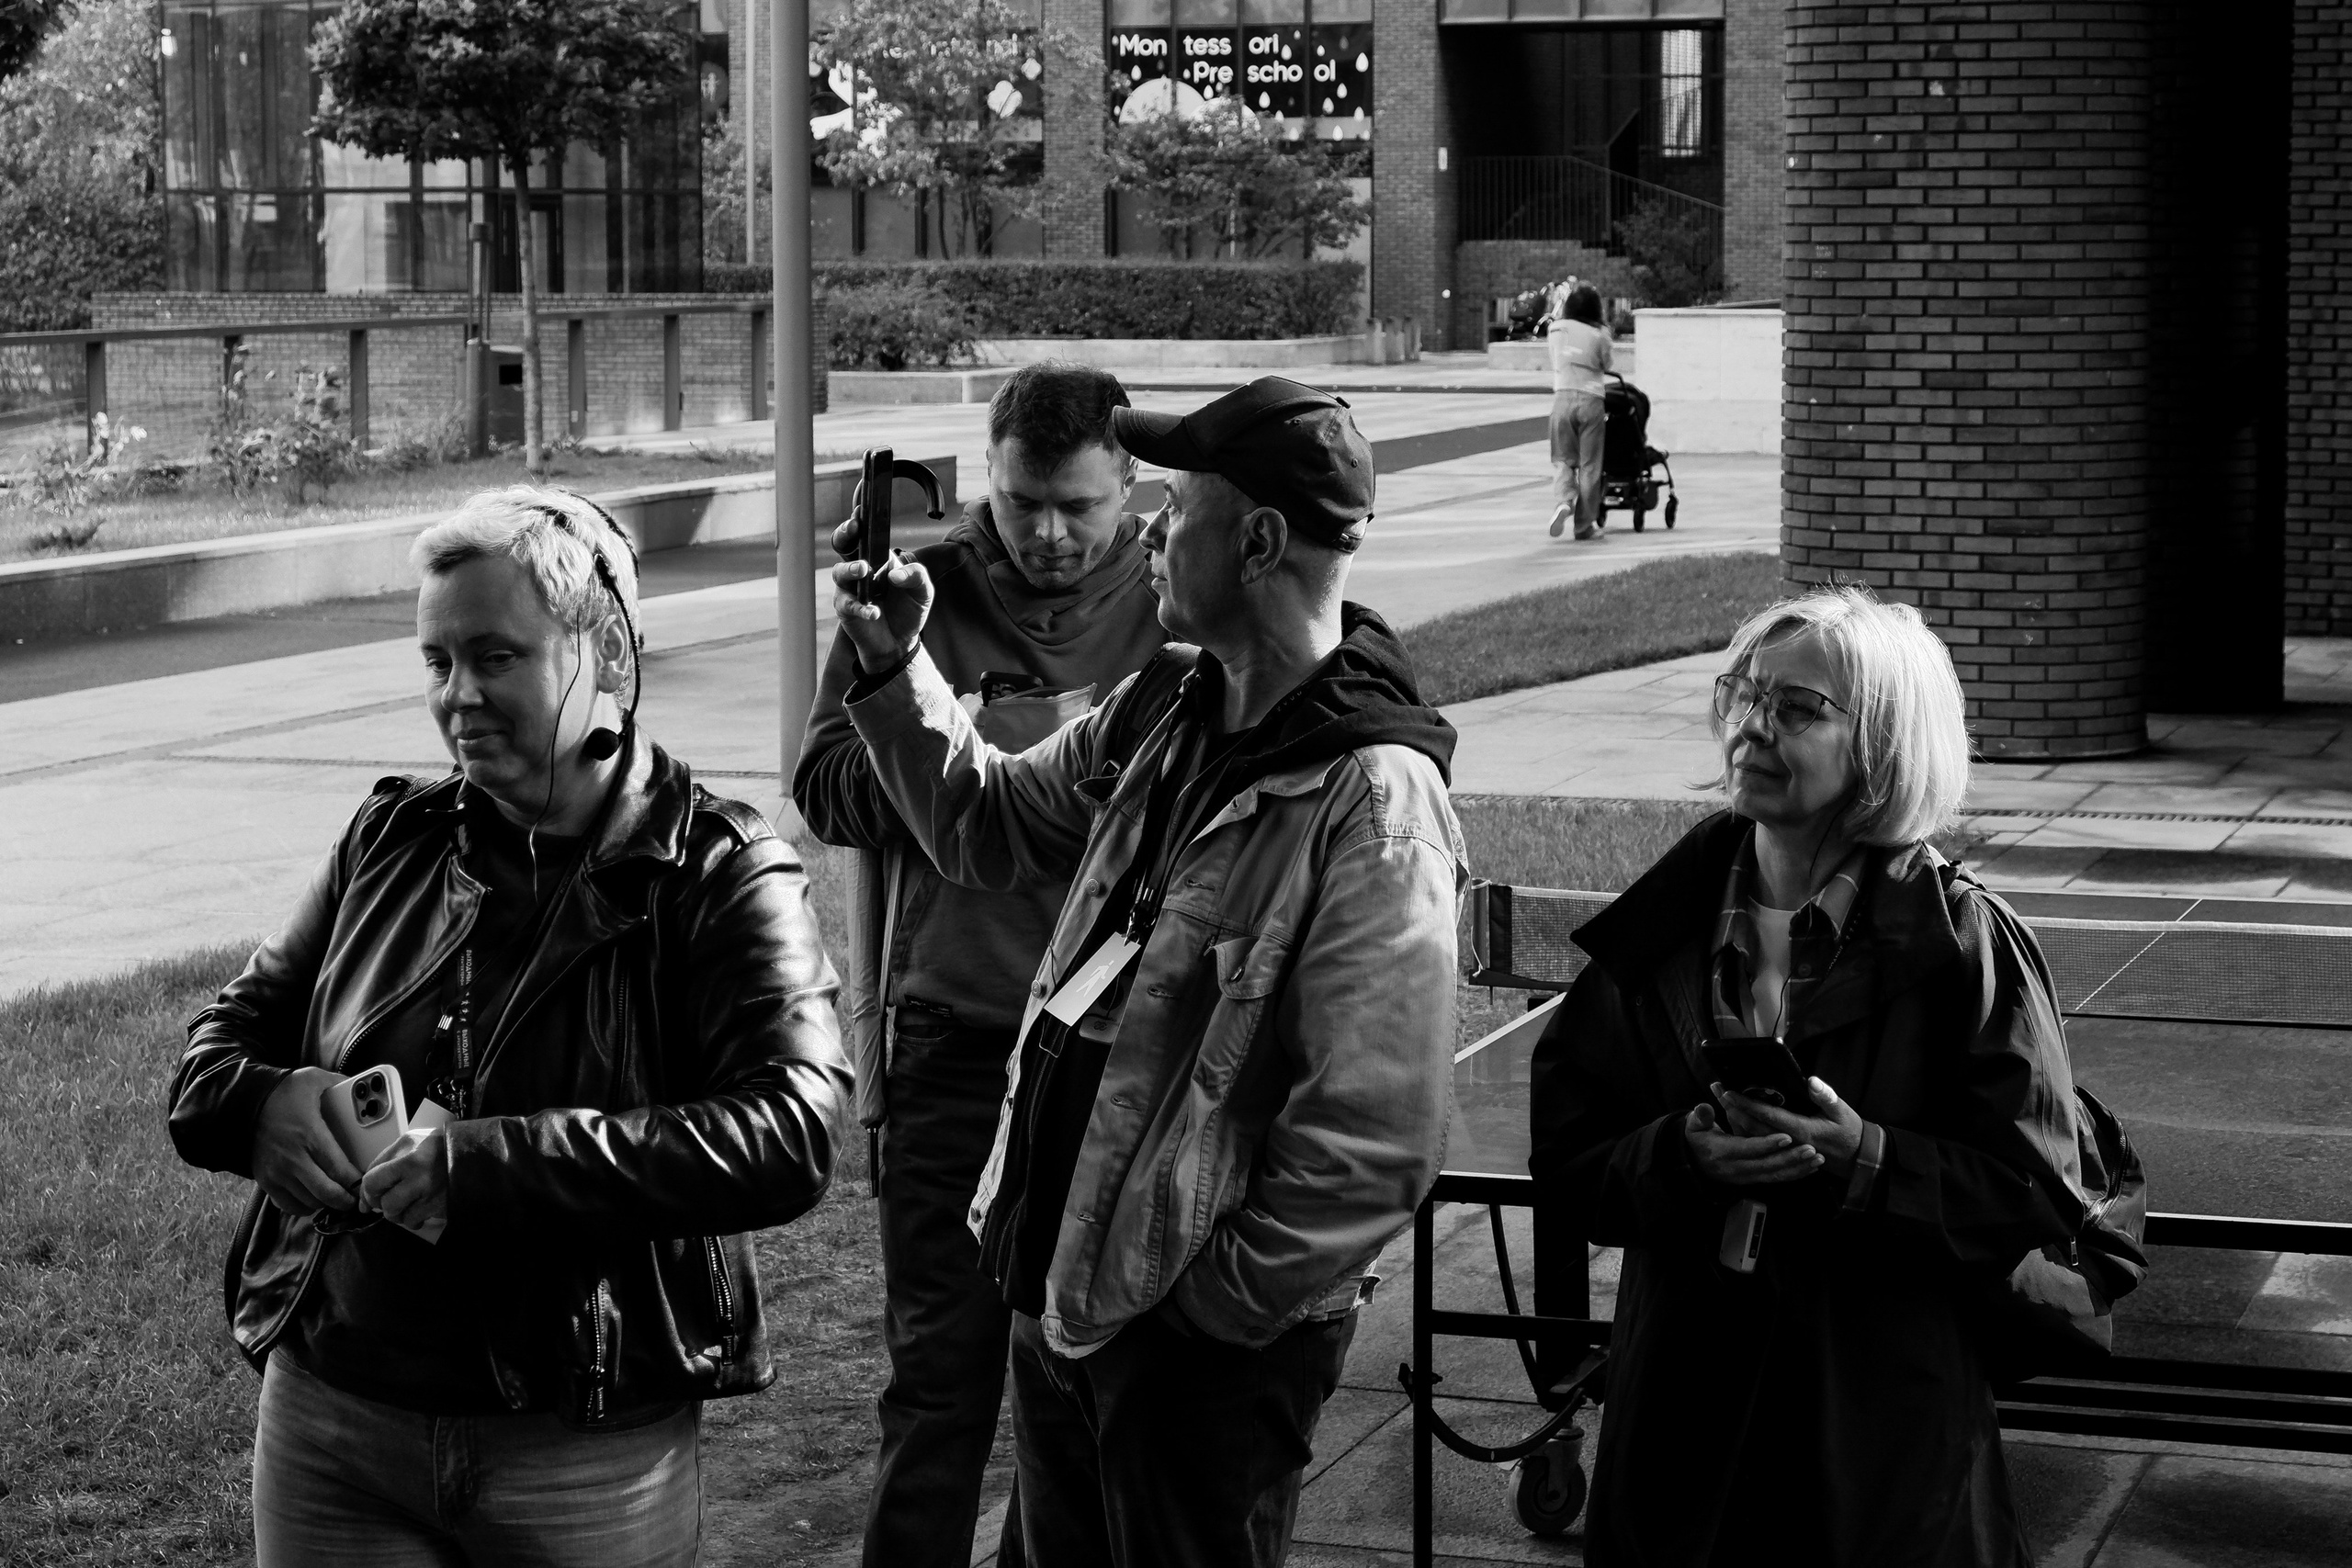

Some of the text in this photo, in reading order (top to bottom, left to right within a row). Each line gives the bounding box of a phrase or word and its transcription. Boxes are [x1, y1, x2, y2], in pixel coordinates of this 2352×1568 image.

[1119, 32, 1280, 57] Mon tess ori
[1193, 58, 1336, 84] Pre scho ol
